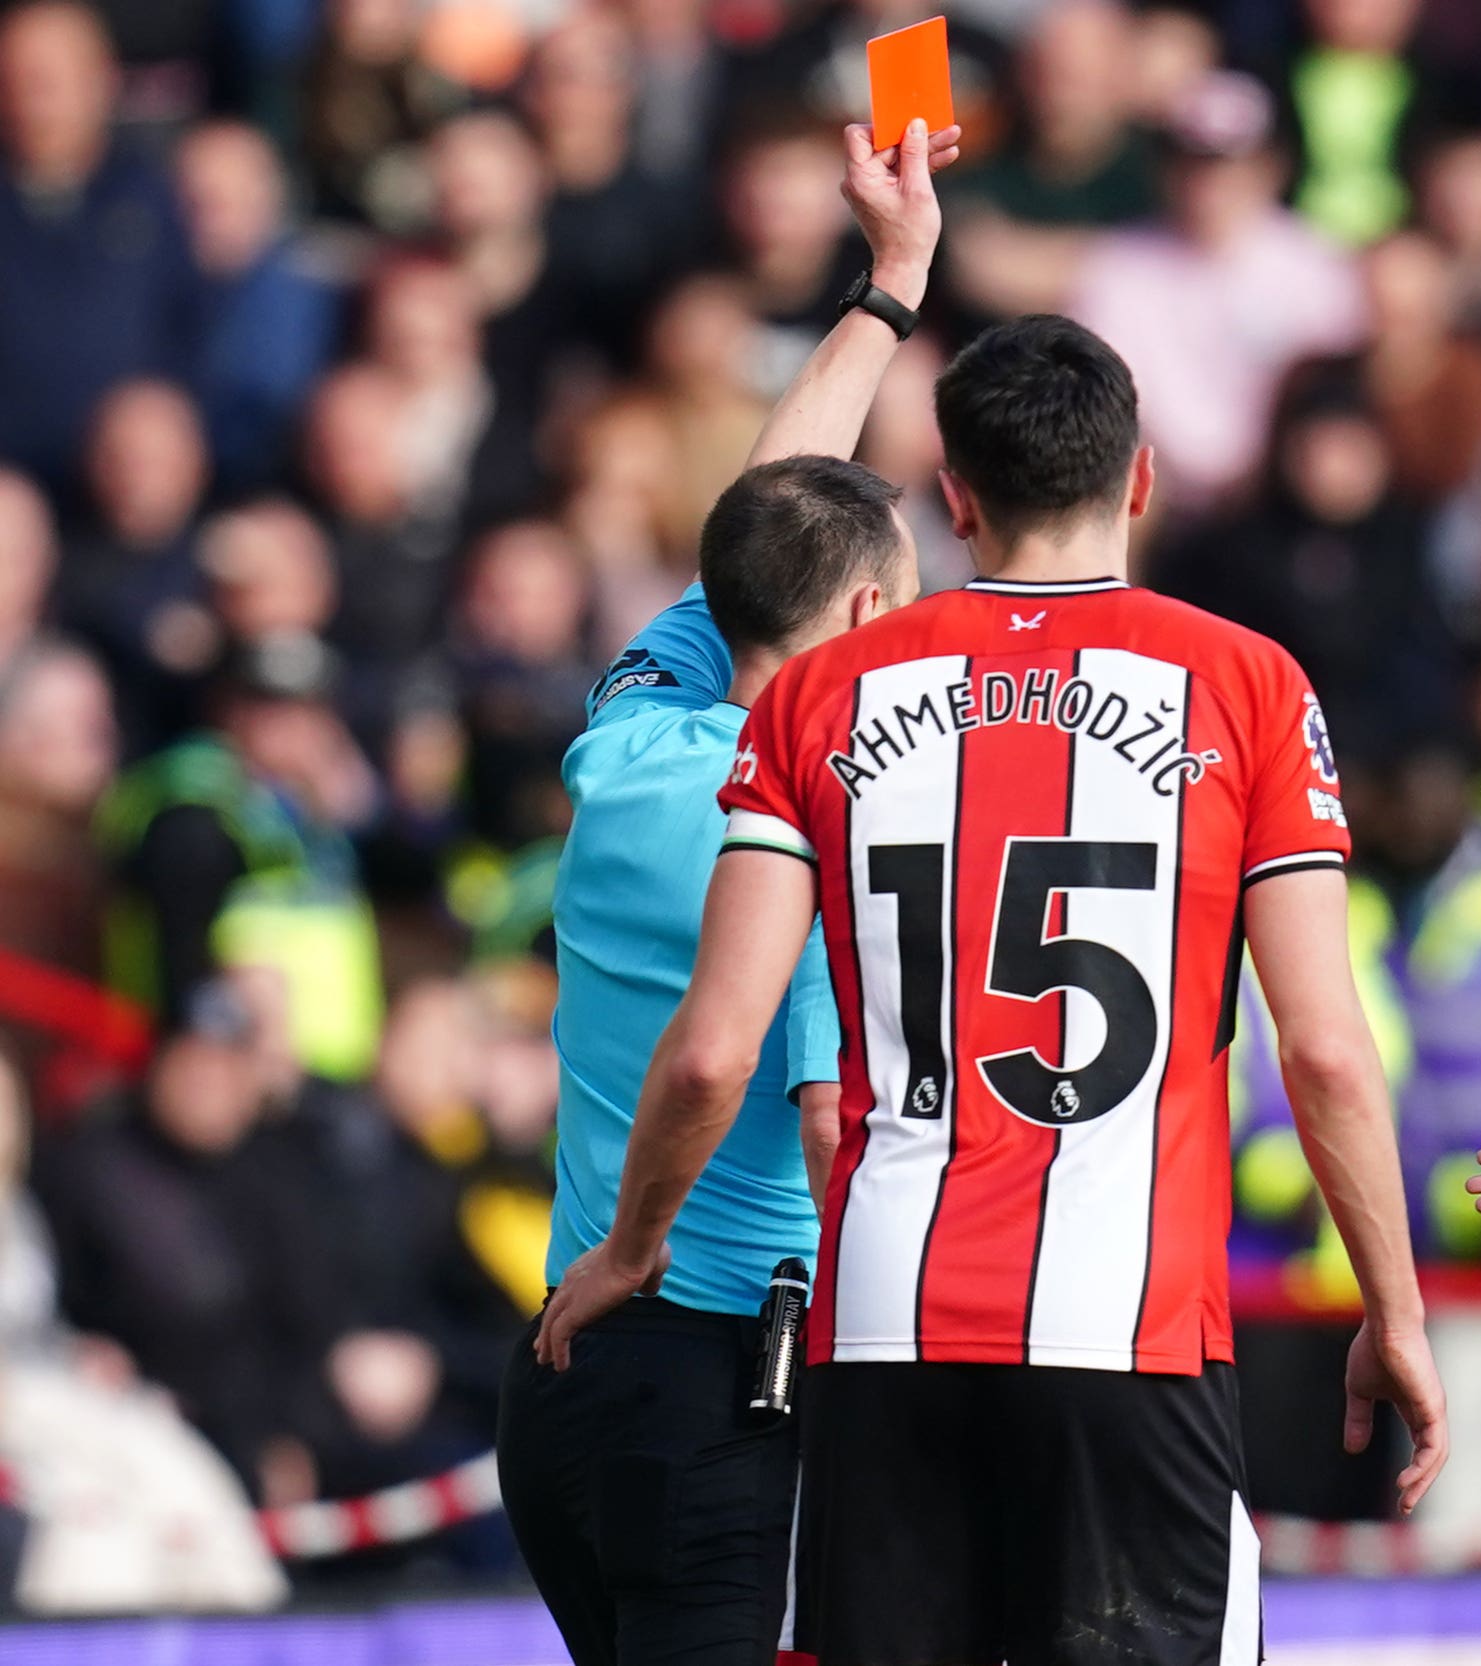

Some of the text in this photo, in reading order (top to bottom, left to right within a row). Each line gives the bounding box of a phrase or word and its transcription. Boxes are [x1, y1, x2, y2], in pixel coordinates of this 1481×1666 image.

[826, 669, 1222, 800] AHMEDHODŽIĆ
[867, 836, 1158, 1128] 15
[783, 1296, 801, 1334] SPRAY
